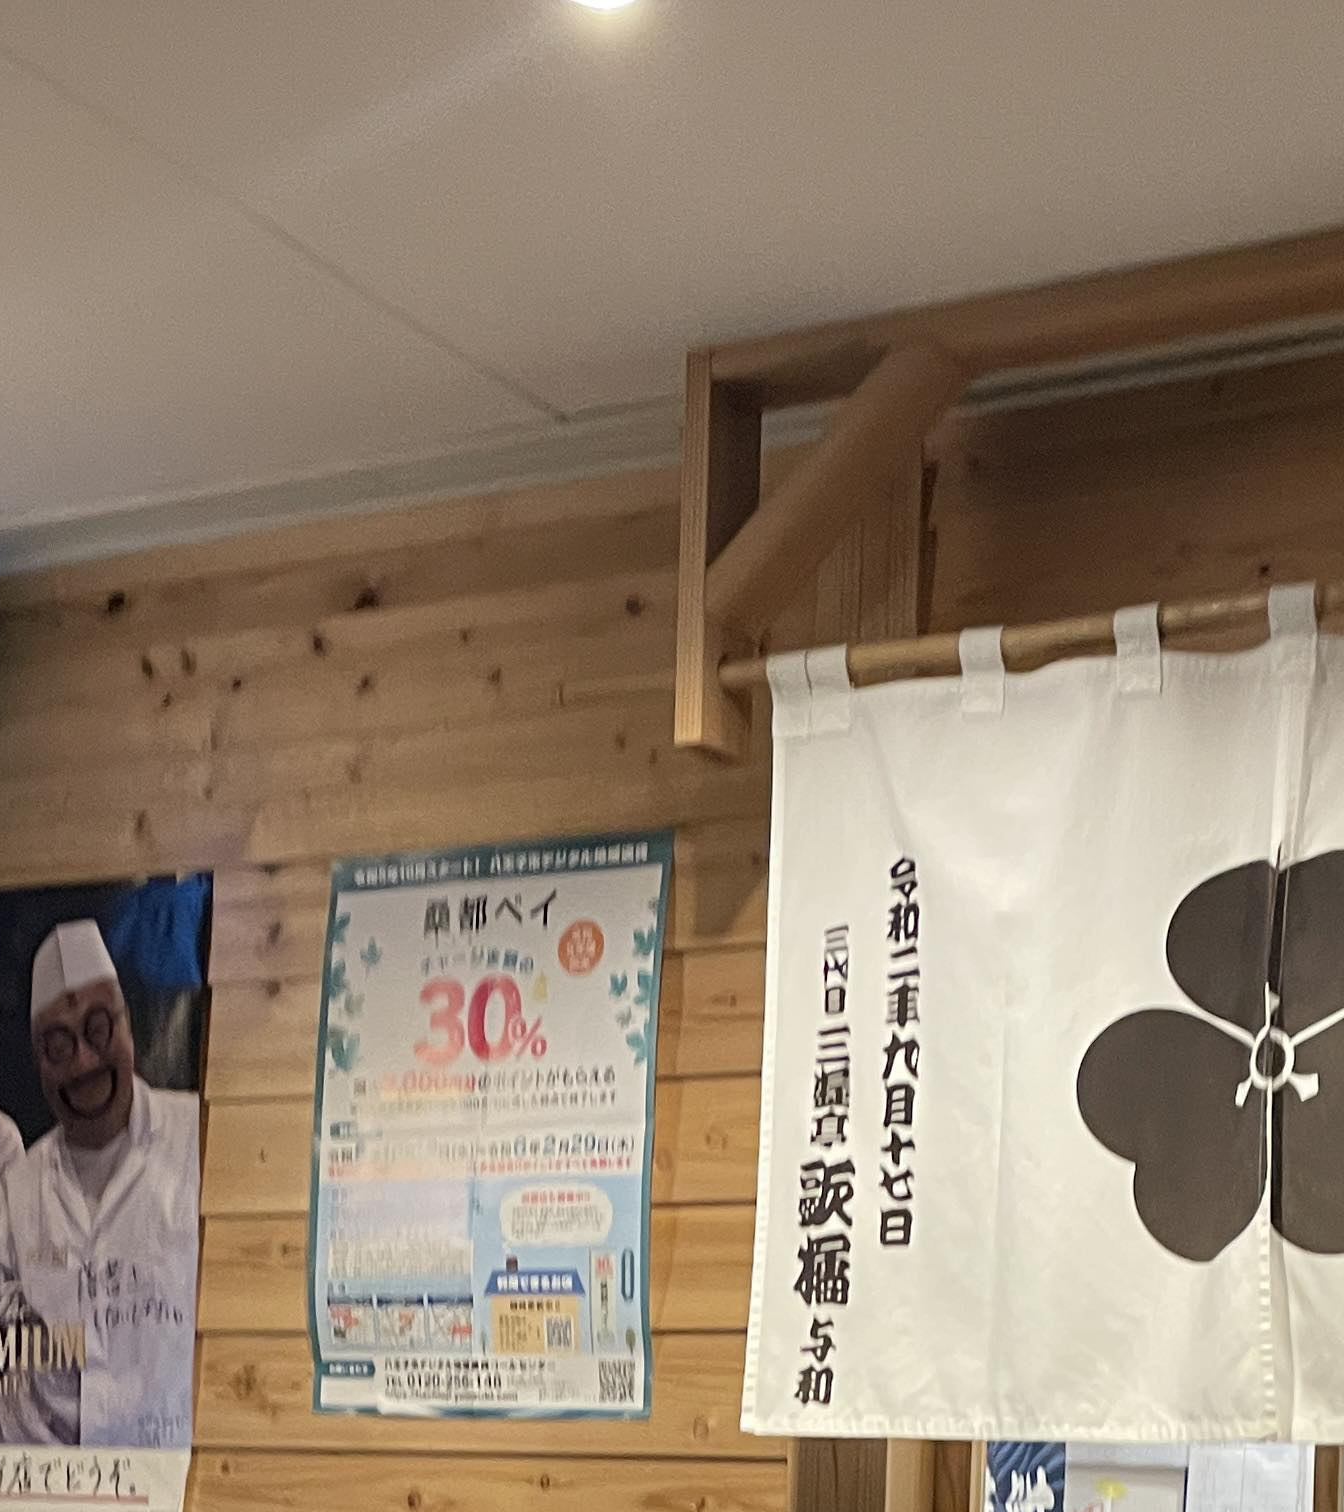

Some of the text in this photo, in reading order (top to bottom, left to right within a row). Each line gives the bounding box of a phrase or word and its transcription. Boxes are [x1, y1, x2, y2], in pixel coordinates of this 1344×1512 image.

[413, 973, 549, 1064] 30%
[879, 857, 920, 1248] 令和二年九月十七日
